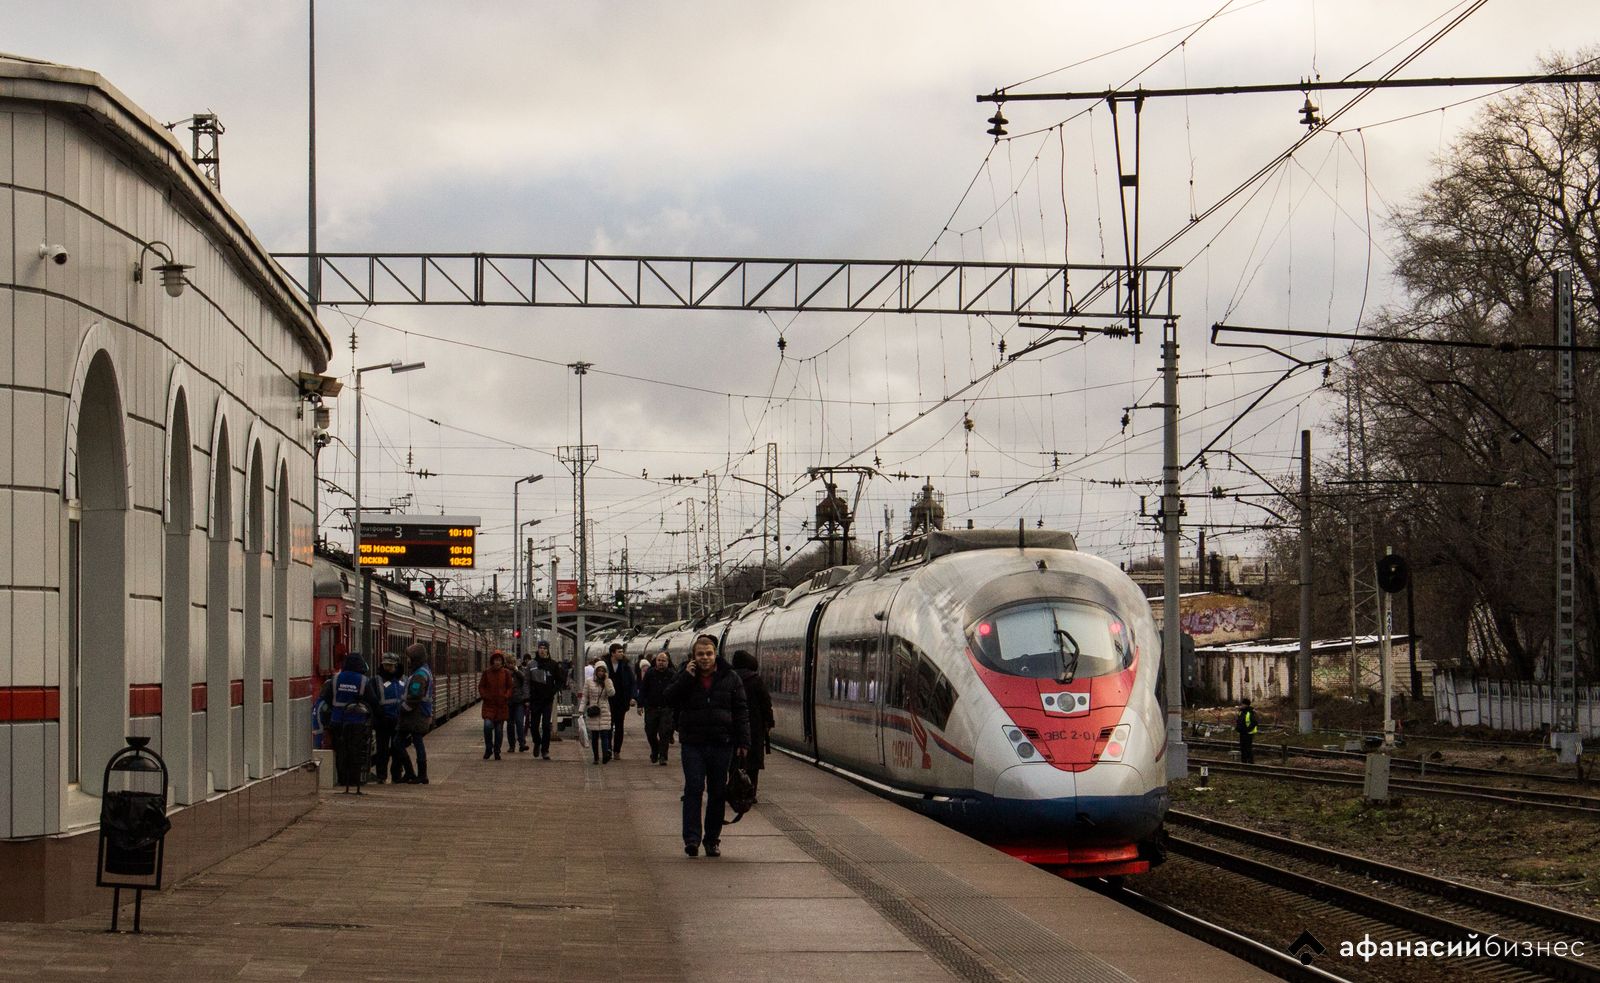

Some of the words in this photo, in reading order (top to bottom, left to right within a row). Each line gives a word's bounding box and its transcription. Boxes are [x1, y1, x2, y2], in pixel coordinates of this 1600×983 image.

[395, 526, 402, 538] 3
[449, 528, 473, 537] 10:10
[450, 545, 473, 555] 10:10
[450, 557, 473, 566] 10:23
[1044, 729, 1068, 742] ЭВС
